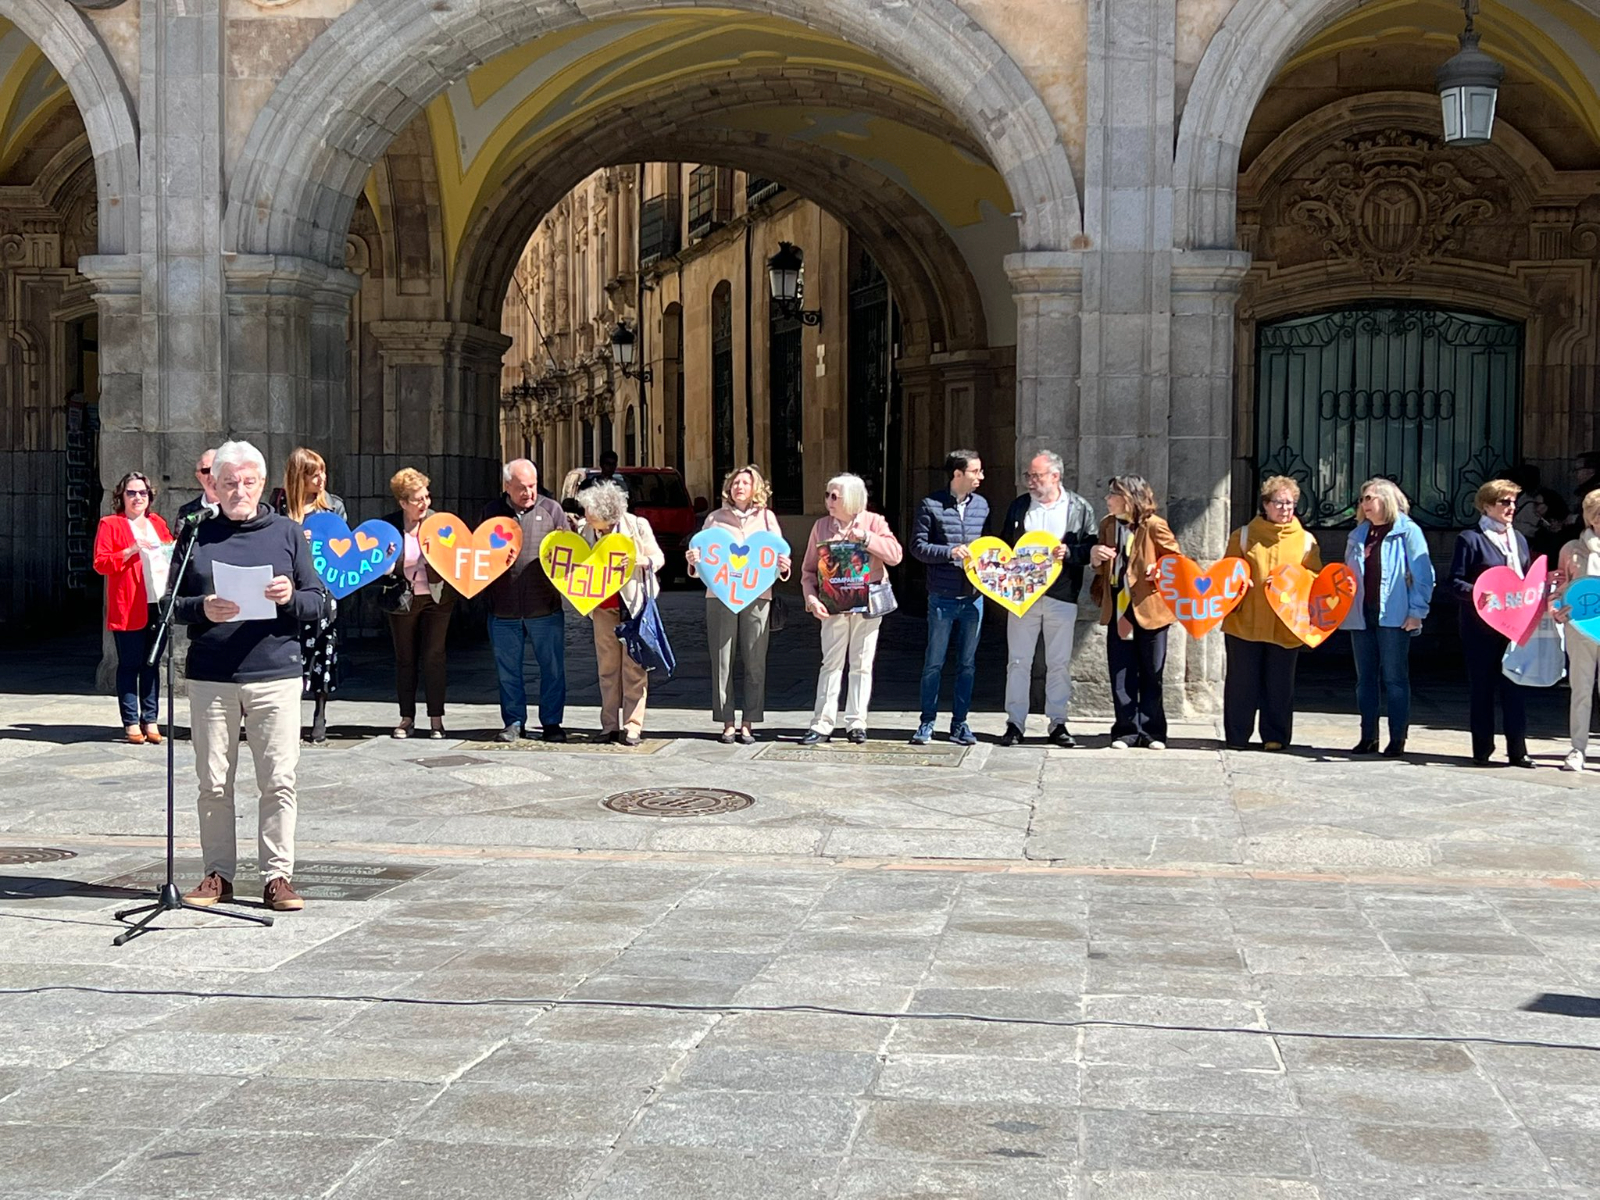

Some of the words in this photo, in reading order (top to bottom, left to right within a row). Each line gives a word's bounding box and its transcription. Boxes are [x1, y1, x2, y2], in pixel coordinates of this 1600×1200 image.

[455, 548, 491, 580] FE
[550, 546, 626, 598] AGUA
[704, 543, 775, 605] SALUD
[1159, 558, 1246, 619] ESCUELA
